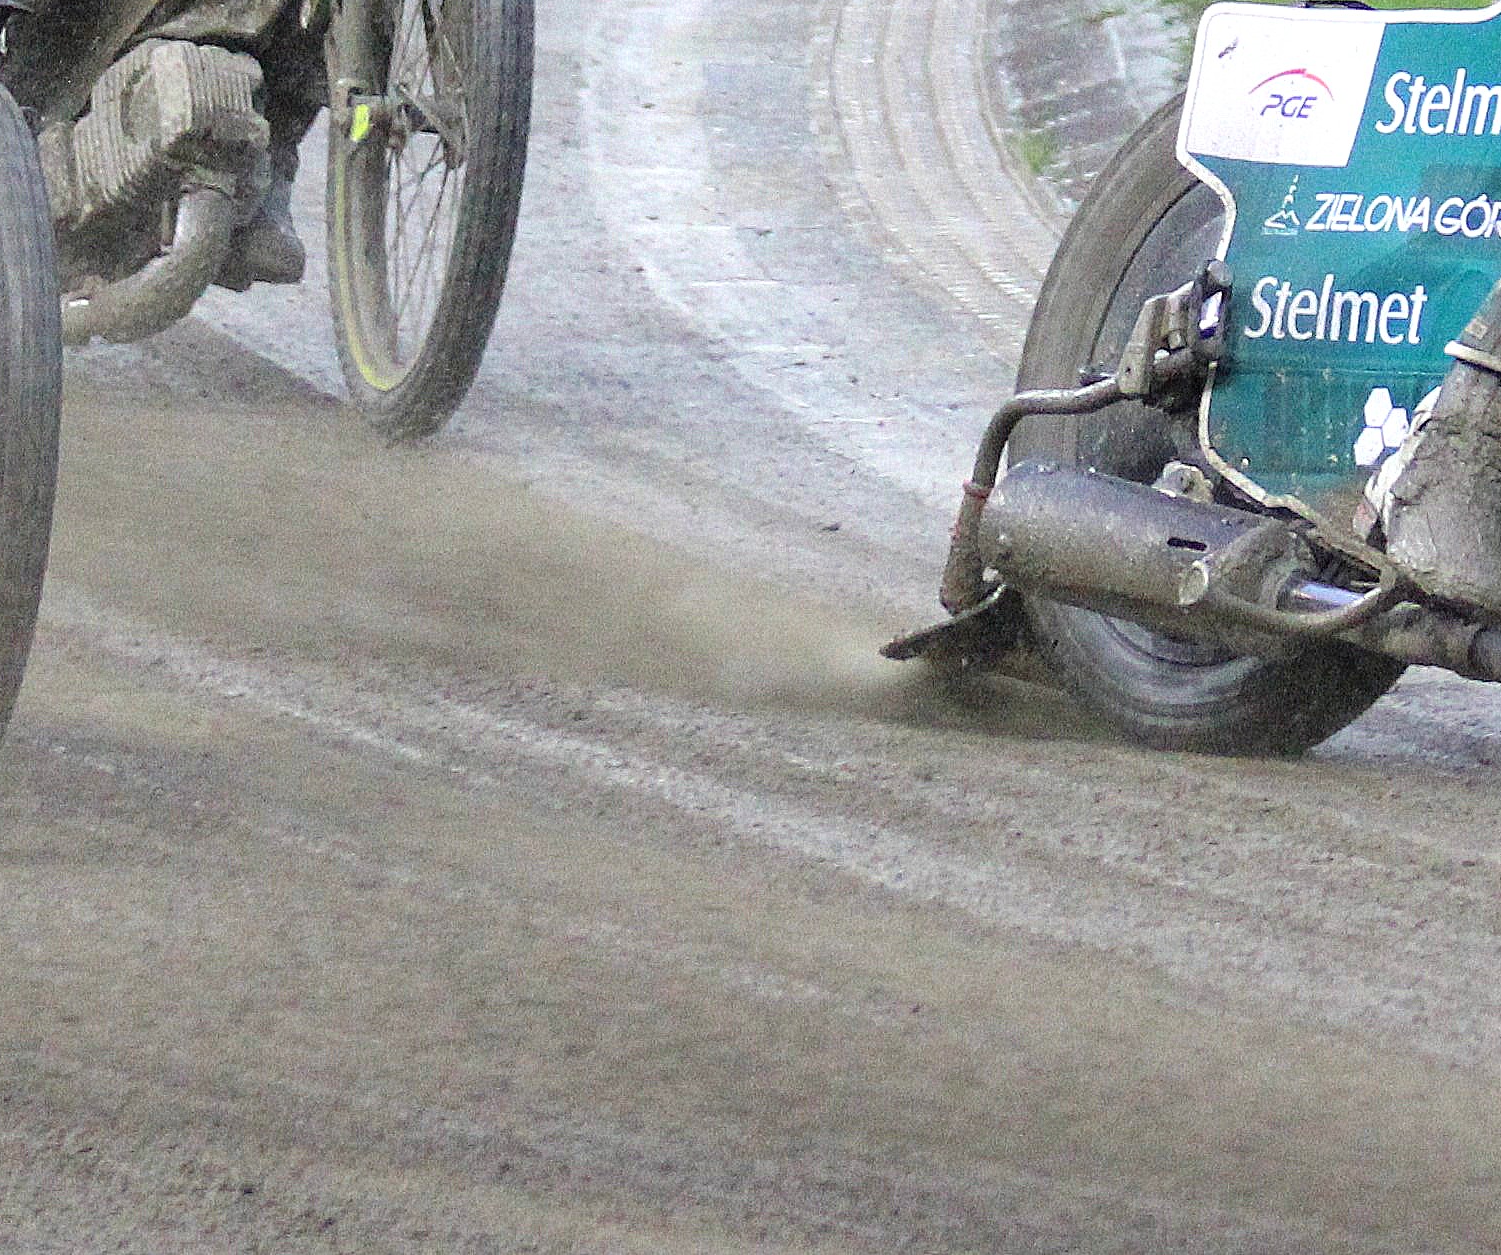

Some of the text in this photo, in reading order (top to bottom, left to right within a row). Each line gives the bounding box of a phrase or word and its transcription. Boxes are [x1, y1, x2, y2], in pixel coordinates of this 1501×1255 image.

[1259, 93, 1318, 119] PGE
[1304, 192, 1430, 233] ZIELONA
[1243, 273, 1428, 345] Stelmet
